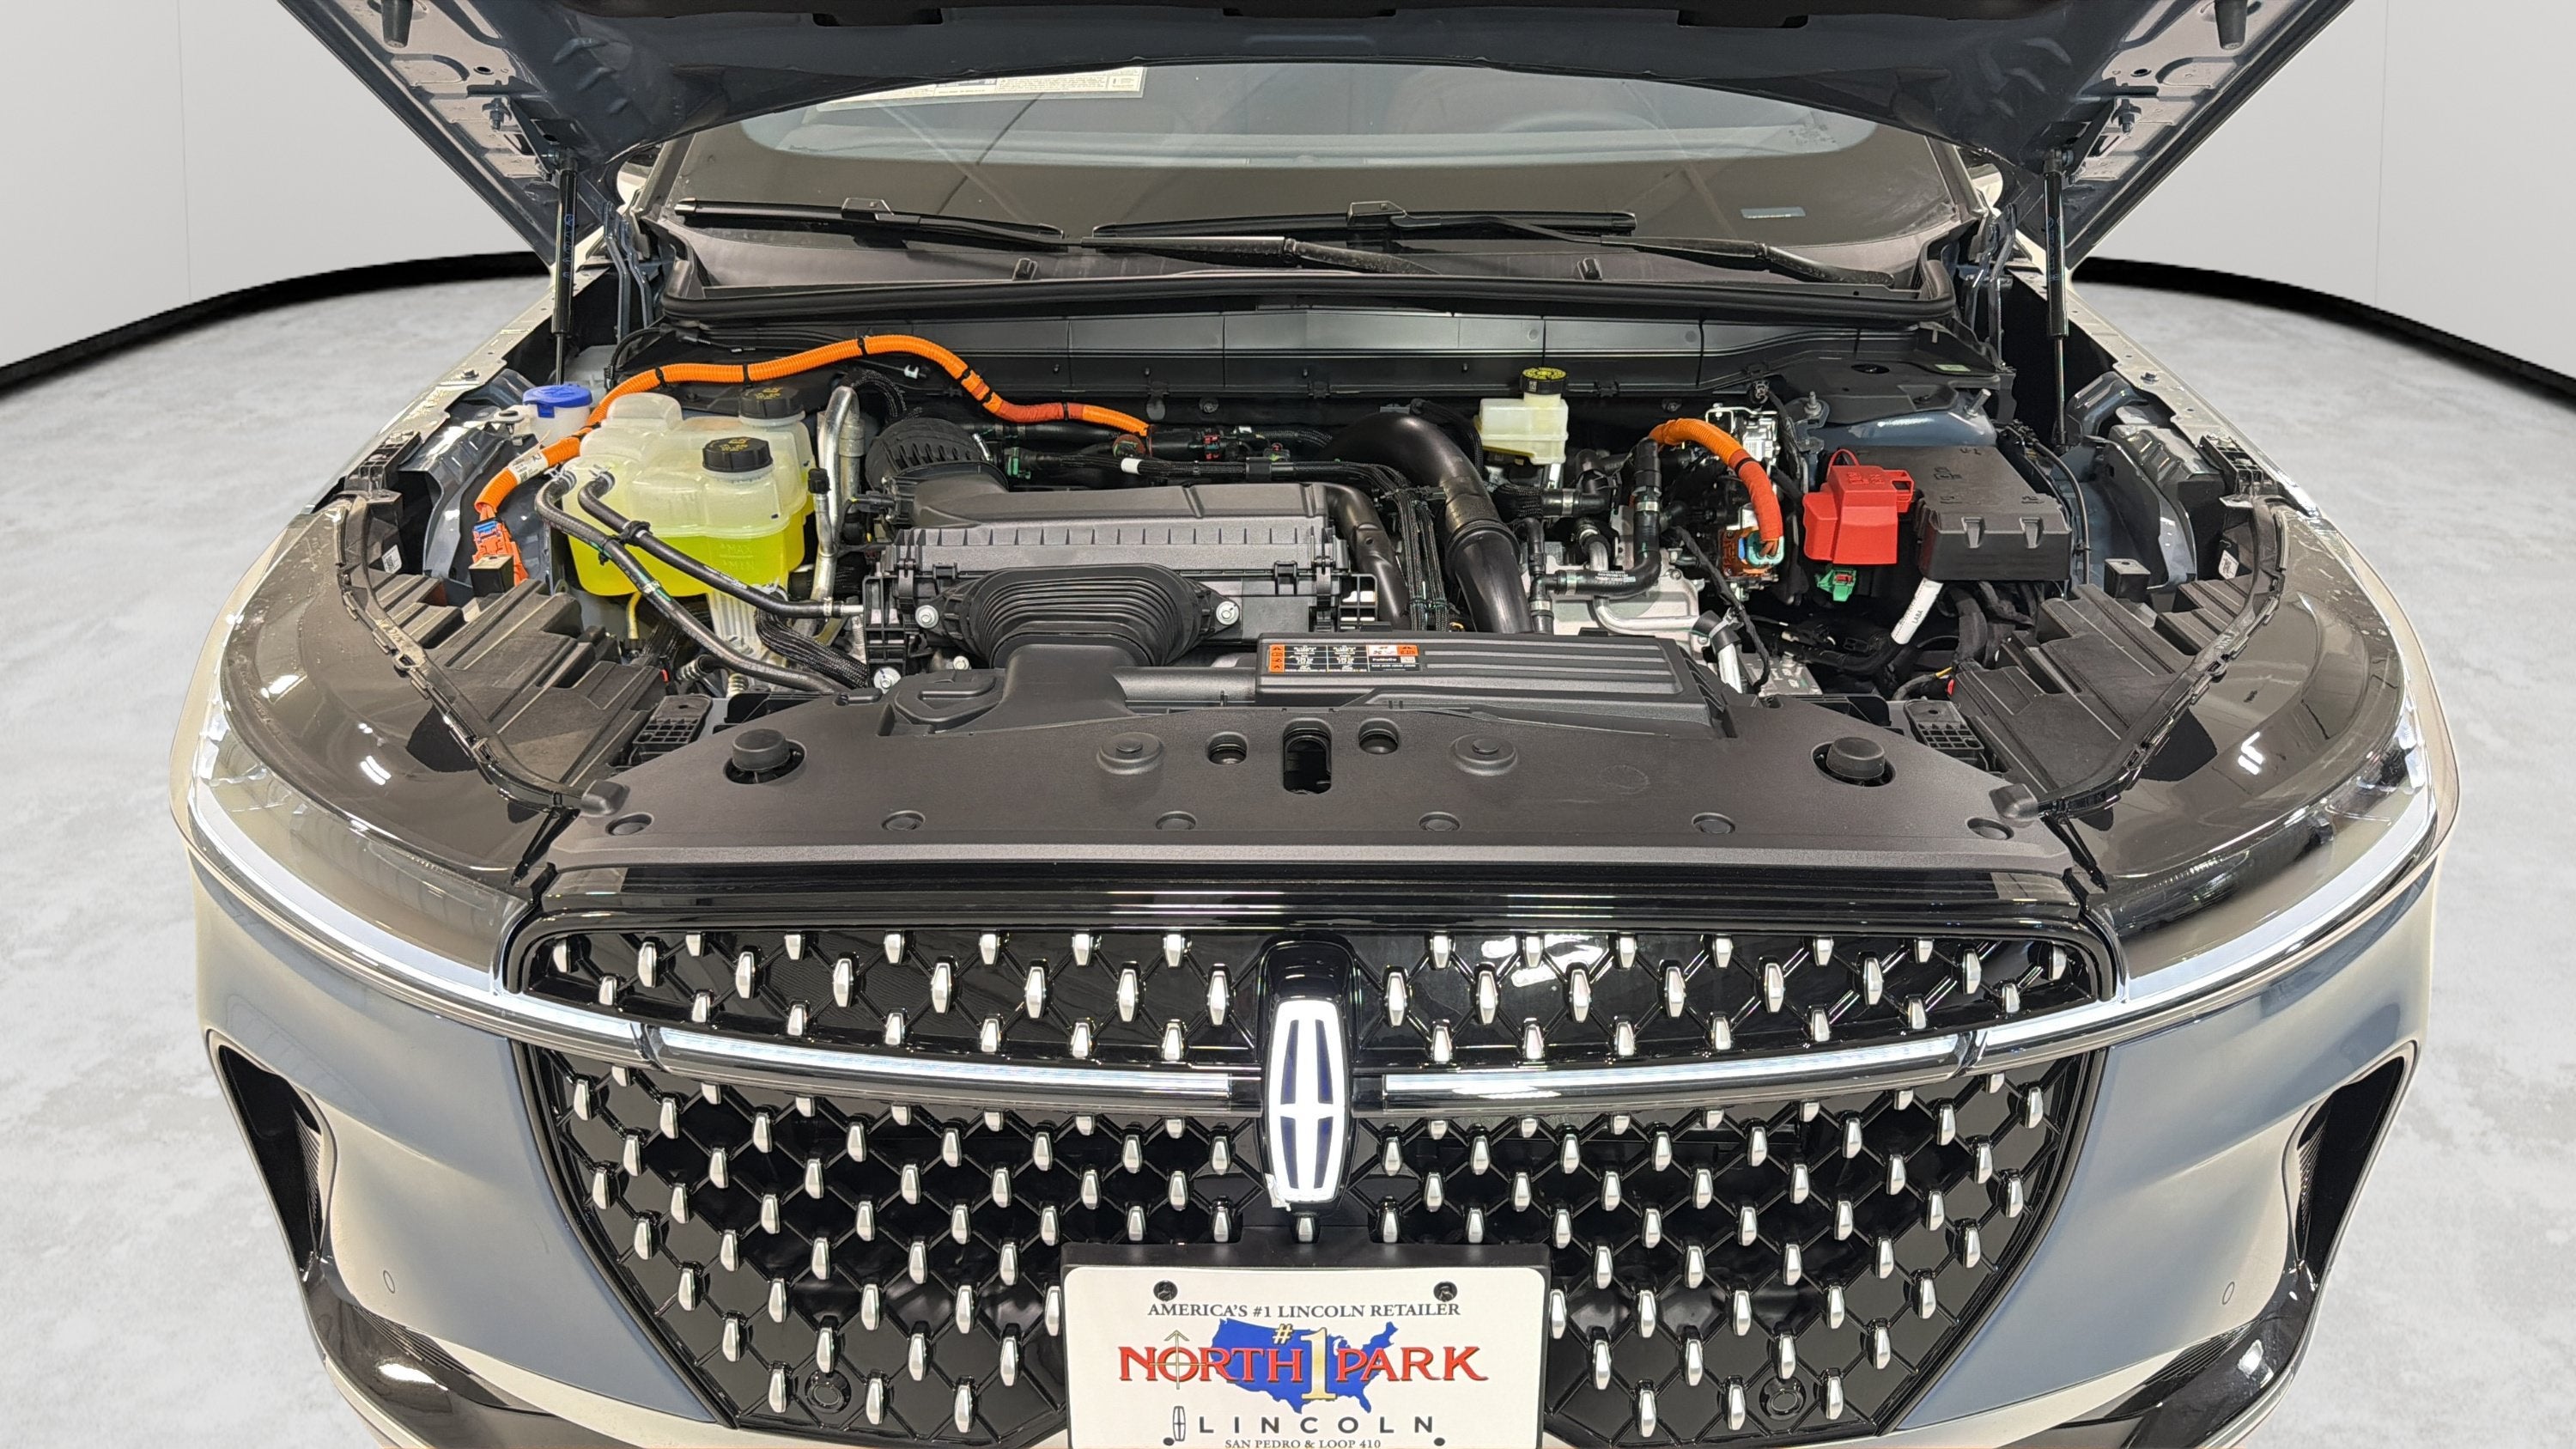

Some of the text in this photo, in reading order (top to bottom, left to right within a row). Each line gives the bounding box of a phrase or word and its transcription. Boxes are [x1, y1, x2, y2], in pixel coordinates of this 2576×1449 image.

[1147, 1303, 1461, 1318] AMERICA'S #1 LINCOLN RETAILER
[1118, 1346, 1490, 1384] NORTH PARK
[1199, 1416, 1433, 1434] LINCOLN
[1224, 1440, 1382, 1449] SAN PEDRO & LOOP 410
